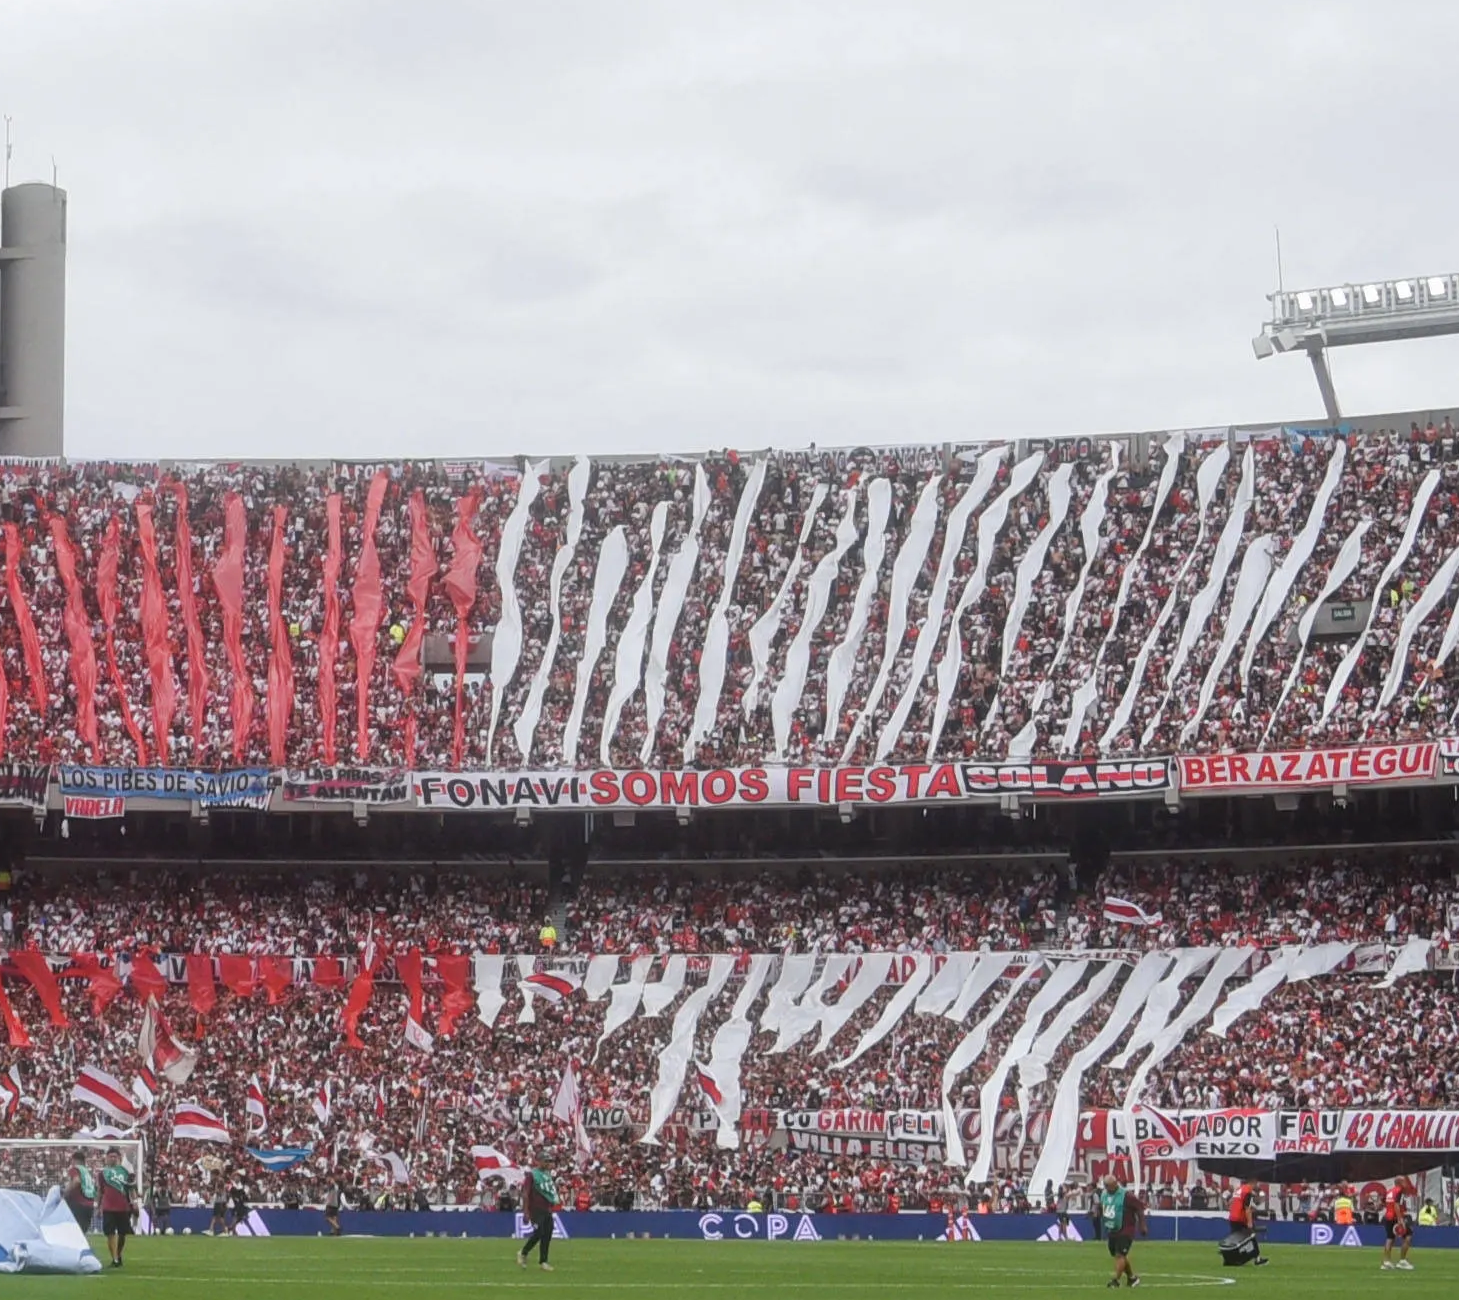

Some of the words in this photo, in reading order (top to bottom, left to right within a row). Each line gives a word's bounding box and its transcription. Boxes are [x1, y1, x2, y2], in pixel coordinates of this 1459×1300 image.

[966, 763, 1165, 792] SOLANO
[1185, 744, 1434, 784] BERAZATEGUI
[164, 772, 187, 794] DE
[194, 773, 248, 797] SAVIO
[420, 777, 579, 807] FONAVI
[590, 769, 769, 805] SOMOS
[787, 764, 961, 803] FIESTA
[889, 1112, 937, 1139] FELI
[1281, 1110, 1338, 1138] FAU
[870, 1139, 942, 1162] ELISA
[1196, 1141, 1260, 1156] ENZO
[1273, 1139, 1330, 1153] MARTA
[699, 1212, 822, 1241] COPA
